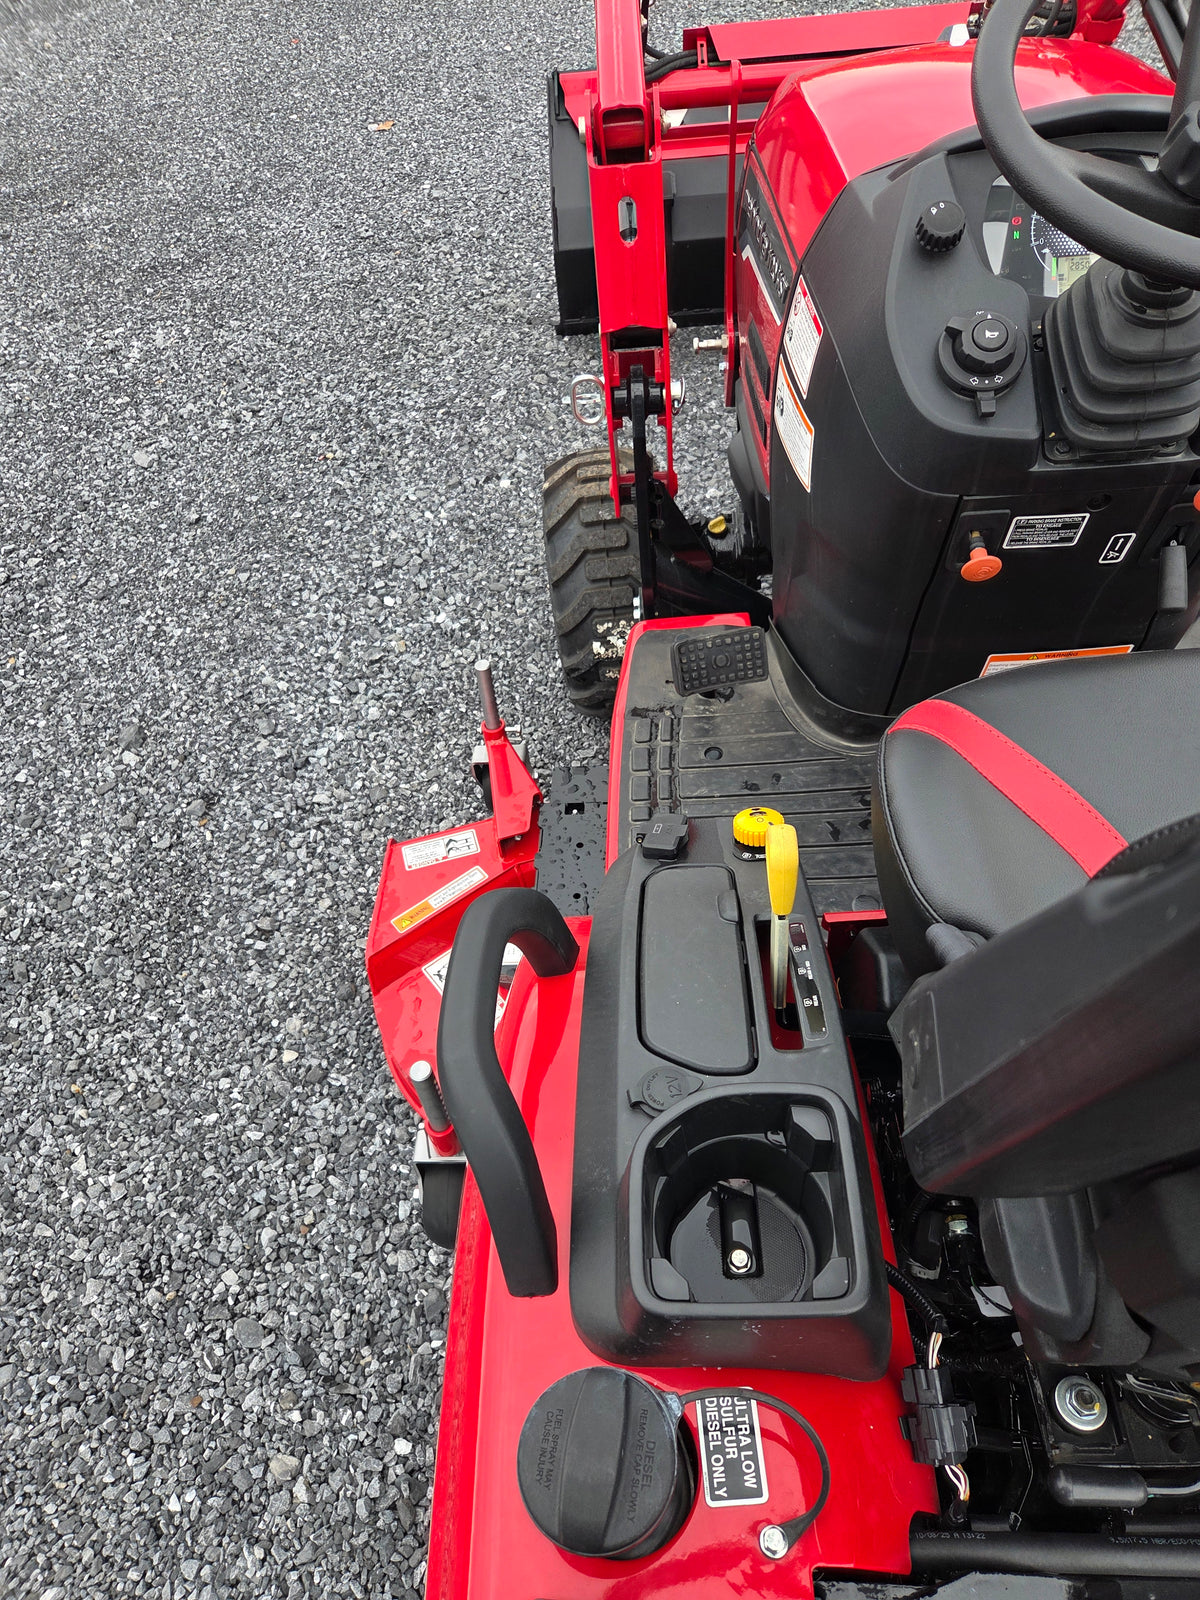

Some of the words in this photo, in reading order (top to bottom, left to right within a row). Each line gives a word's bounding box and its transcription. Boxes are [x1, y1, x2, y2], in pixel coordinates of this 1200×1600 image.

[1013, 231, 1019, 239] N
[664, 1075, 683, 1098] 12V
[541, 1410, 553, 1445] CAUSE
[552, 1408, 564, 1431] FUEL
[636, 1408, 648, 1452] REMOVE
[705, 1397, 721, 1450] DIESEL
[720, 1396, 738, 1459] SULFUR
[535, 1446, 547, 1485] INJURY
[547, 1434, 559, 1466] SPRAY
[631, 1454, 642, 1475] CAP
[641, 1440, 656, 1491] DIESEL
[741, 1450, 757, 1489] LOW
[543, 1467, 555, 1490] MAY
[711, 1454, 727, 1497] ONLY
[626, 1477, 639, 1524] SLOWLY
